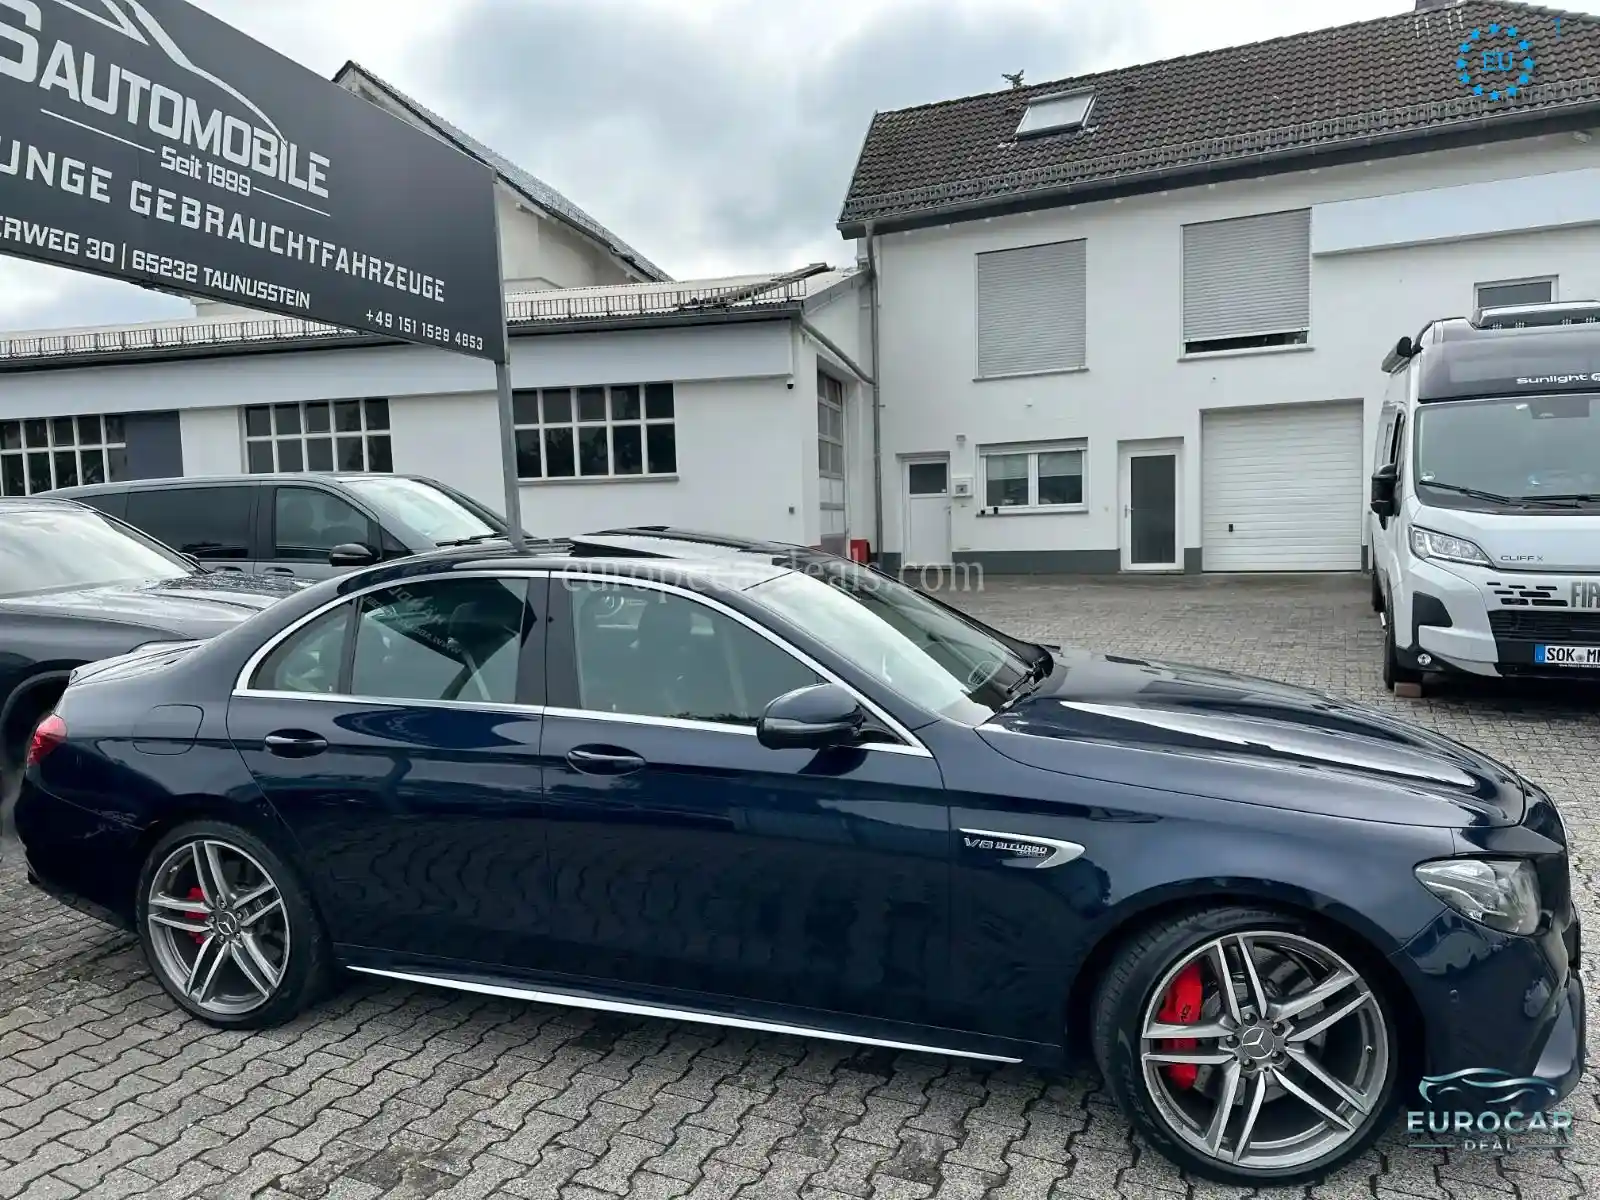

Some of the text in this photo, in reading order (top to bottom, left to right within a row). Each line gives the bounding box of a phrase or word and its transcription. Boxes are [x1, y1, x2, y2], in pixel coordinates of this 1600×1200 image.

[160, 145, 251, 197] Seit 1999
[0, 215, 79, 255] RWEG
[85, 237, 115, 264] 30
[132, 249, 198, 283] 65232
[203, 267, 310, 309] TAUNUSSTEIN
[130, 180, 445, 302] GEBRAUCHTFAHRZEUGE
[366, 309, 393, 328] +49
[398, 316, 417, 335] 151
[421, 322, 450, 343] 1529
[1547, 648, 1600, 662] SOK M
[964, 837, 993, 849] V8
